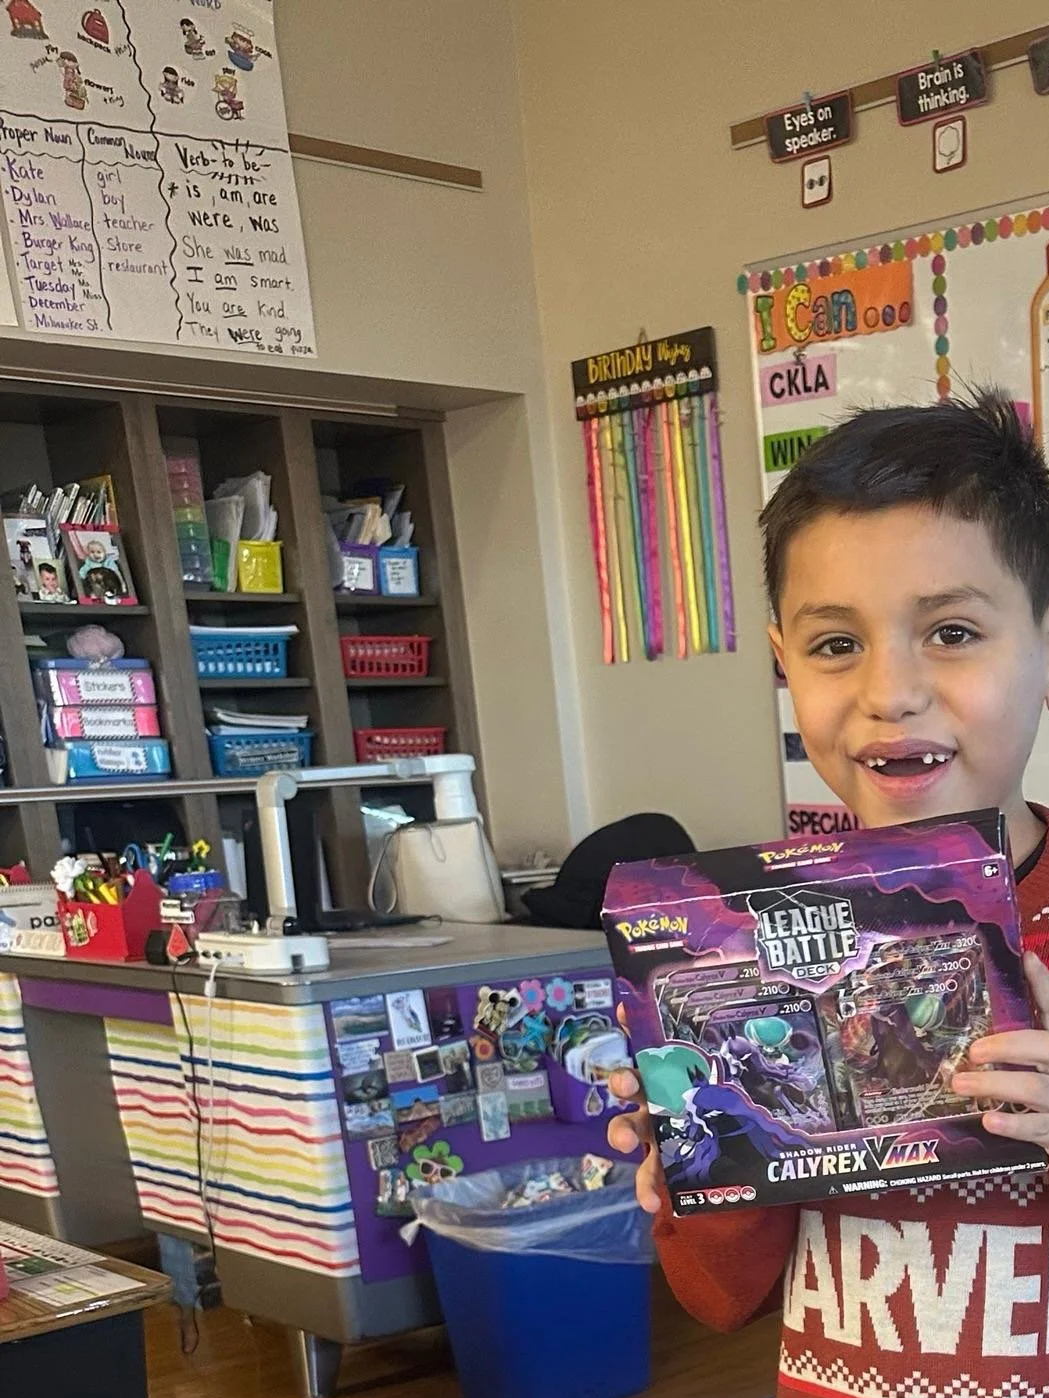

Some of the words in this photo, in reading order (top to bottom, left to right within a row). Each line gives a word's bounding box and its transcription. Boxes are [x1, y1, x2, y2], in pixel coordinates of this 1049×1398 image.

[918, 67, 952, 90] Brain
[953, 62, 964, 78] is
[918, 85, 970, 113] thinking.
[783, 110, 815, 131] Eyes
[817, 105, 832, 121] on
[44, 128, 72, 145] Noun
[87, 126, 126, 146] Common
[784, 127, 837, 154] speaker.
[6, 156, 44, 181] Kate
[97, 169, 121, 184] girl
[11, 185, 57, 205] Dylan
[101, 190, 125, 213] boy
[254, 192, 277, 206] are
[50, 212, 91, 230] Wallace
[104, 214, 154, 231] teacher
[249, 215, 279, 233] was
[23, 232, 63, 255] Burger
[69, 236, 95, 262] King
[182, 235, 214, 259] She
[224, 247, 252, 262] was
[20, 251, 64, 275] Target
[108, 261, 168, 275] restaurant
[187, 267, 204, 283] I
[214, 273, 238, 286] am
[24, 276, 75, 300] Tuesday
[29, 296, 85, 311] December
[187, 291, 210, 314] You
[223, 302, 246, 315] are
[185, 321, 220, 341] They
[228, 327, 263, 342] were
[275, 326, 302, 342] going
[754, 295, 776, 352] I
[769, 364, 829, 400] CKLA
[84, 681, 126, 692] Stickers
[984, 865, 998, 876] 6+
[762, 902, 850, 939] LEAGUE
[765, 931, 858, 967] BATTLE
[743, 968, 759, 978] 210
[796, 964, 837, 978] DECK
[762, 985, 778, 995] 210
[928, 982, 945, 993] 320
[783, 1004, 800, 1014] 210
[767, 1150, 869, 1182] CALYREX
[863, 1132, 940, 1171] VMAX
[779, 1147, 822, 1159] SHADOW
[826, 1143, 857, 1153] RIDER
[842, 1179, 889, 1193] WARNING:
[917, 1174, 941, 1184] HAZARD
[697, 1193, 705, 1205] 3
